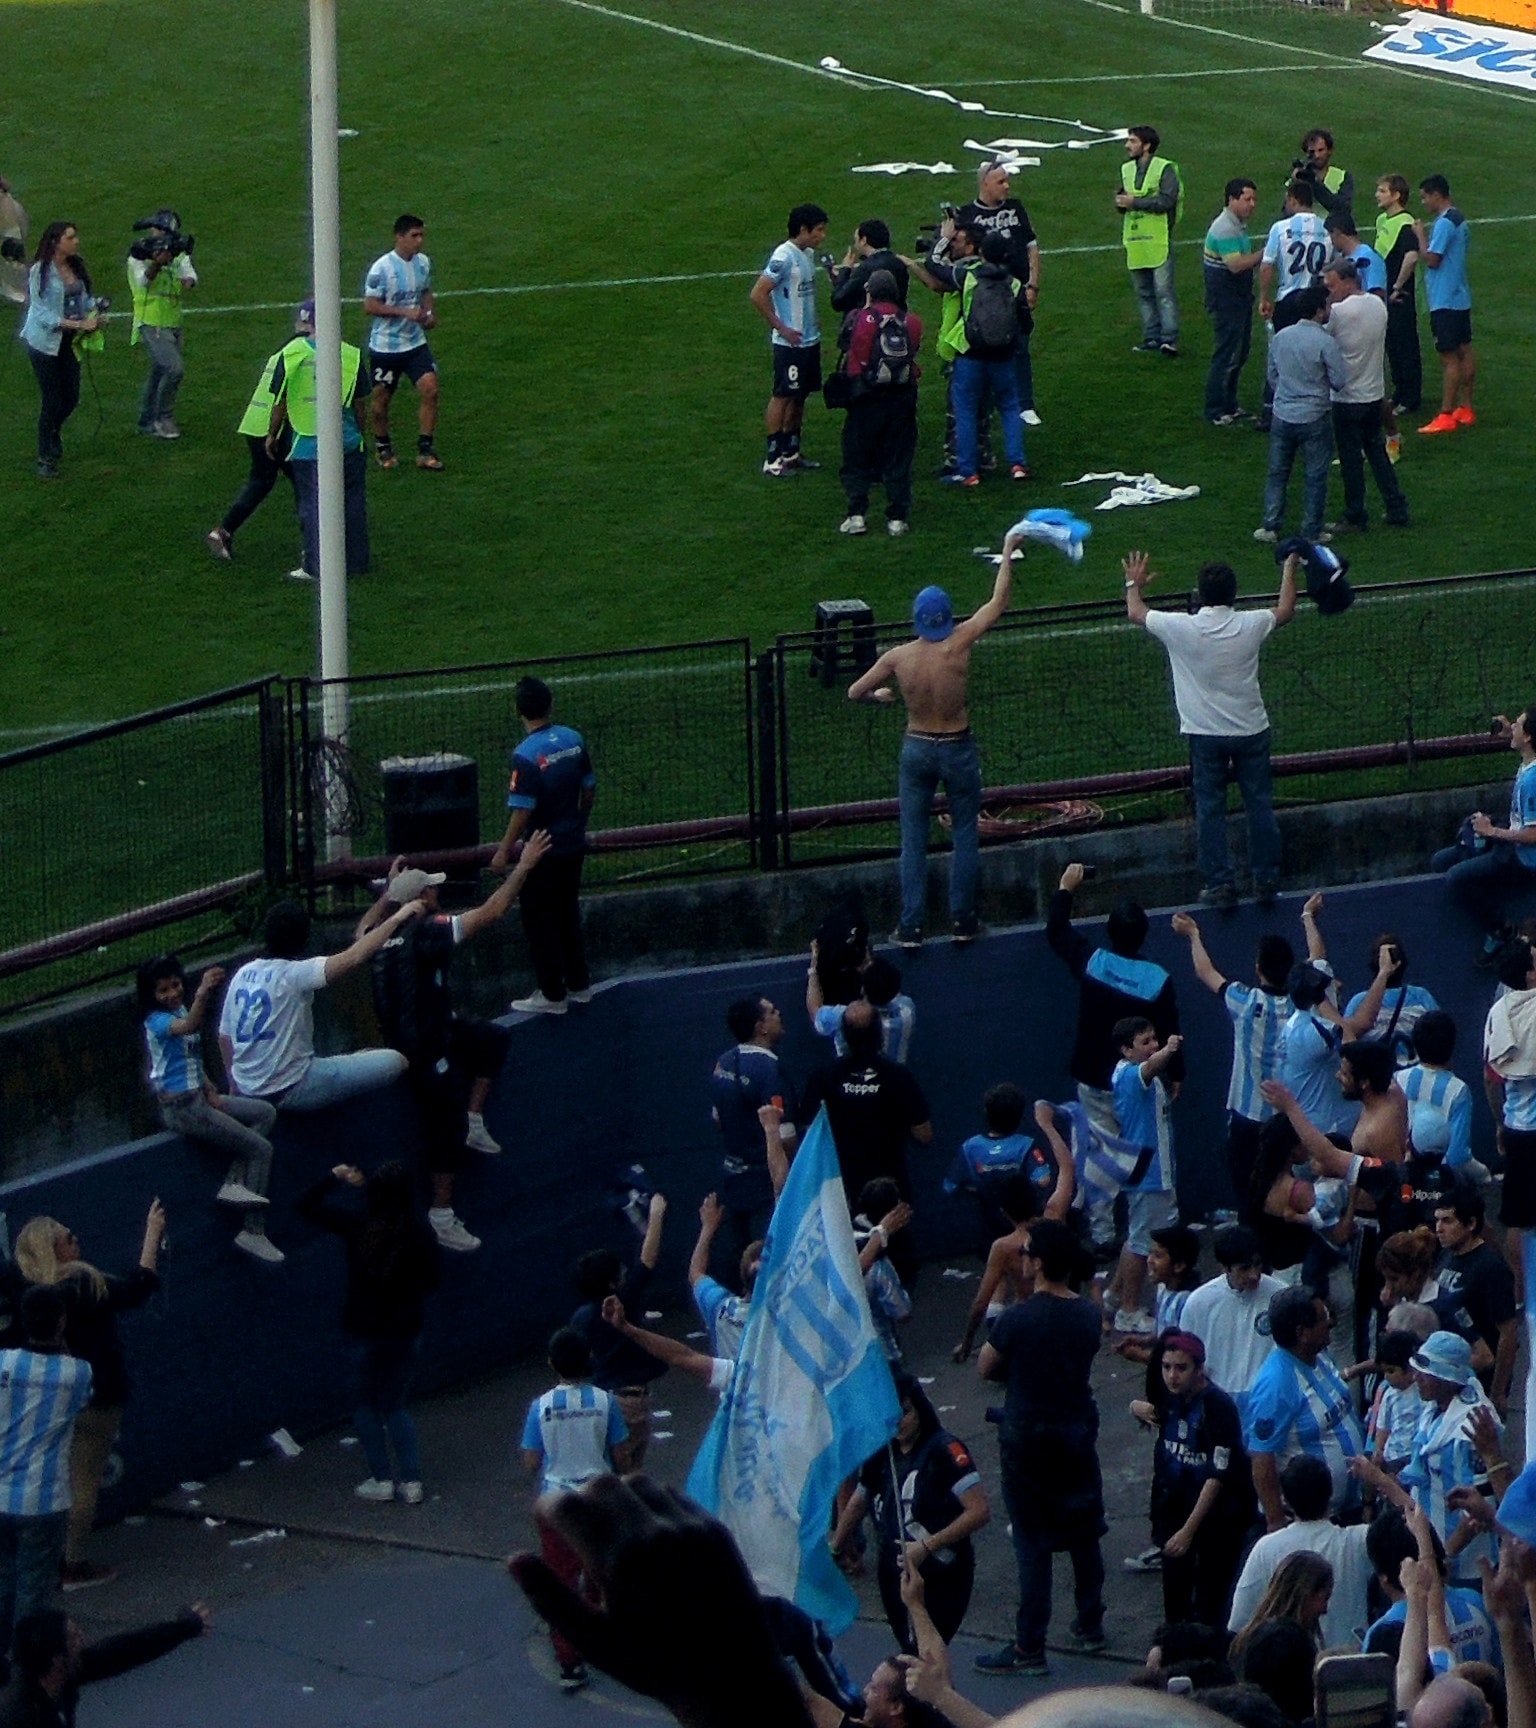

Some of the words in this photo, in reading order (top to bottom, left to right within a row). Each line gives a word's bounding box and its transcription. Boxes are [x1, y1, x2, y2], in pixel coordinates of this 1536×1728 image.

[1287, 240, 1327, 275] 20
[373, 367, 394, 384] 24
[235, 988, 274, 1043] 22
[842, 1084, 881, 1097] Topper
